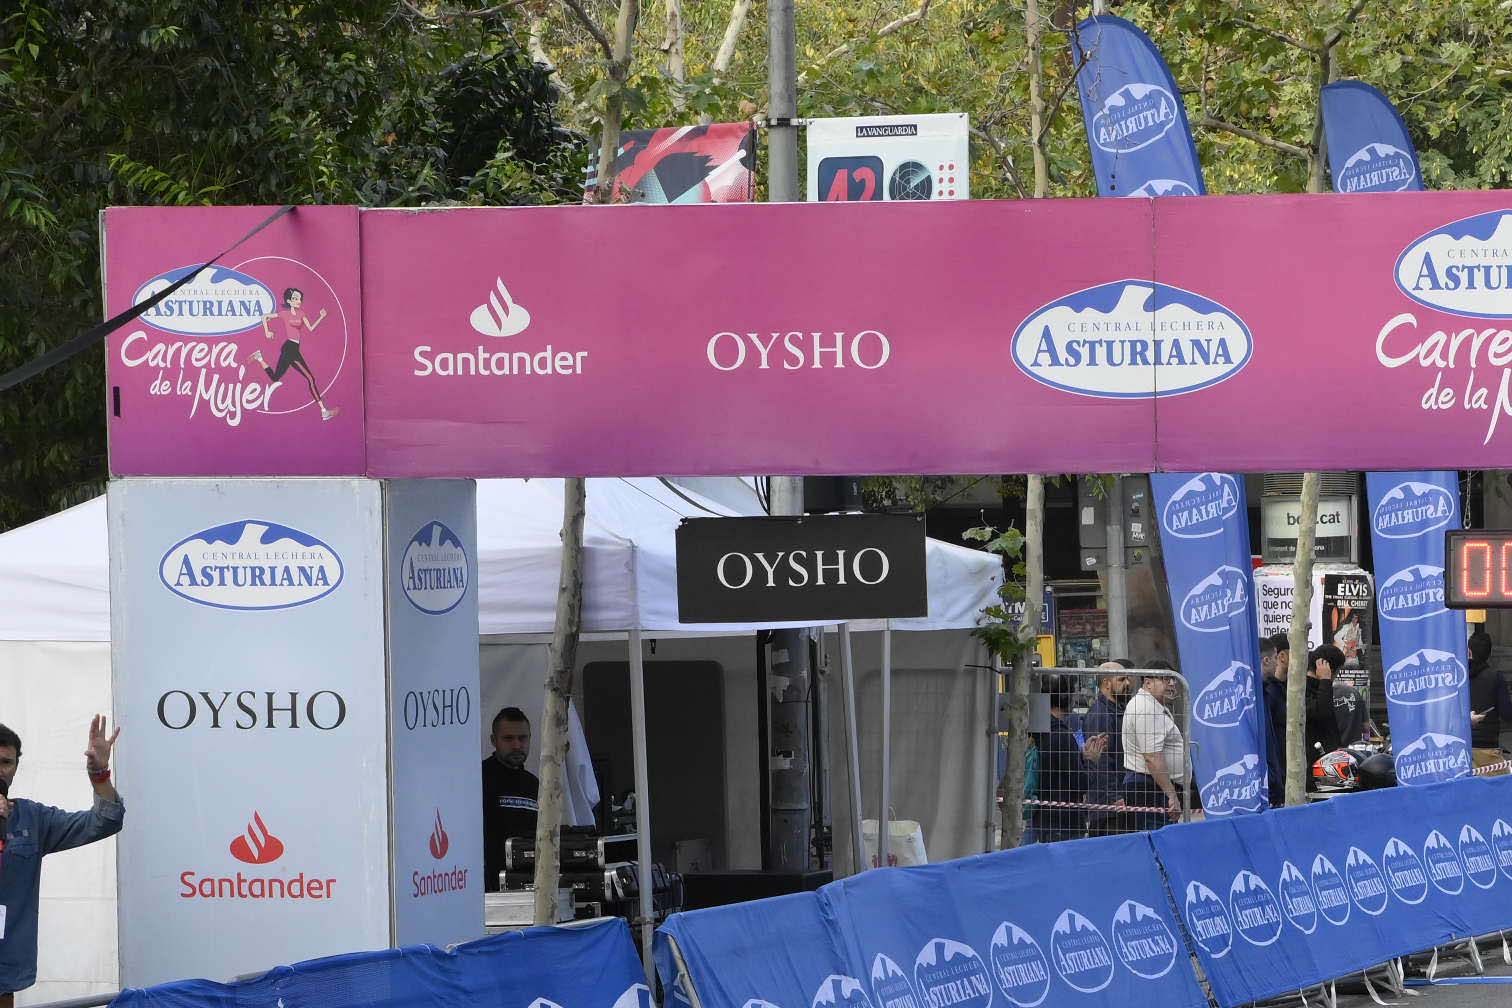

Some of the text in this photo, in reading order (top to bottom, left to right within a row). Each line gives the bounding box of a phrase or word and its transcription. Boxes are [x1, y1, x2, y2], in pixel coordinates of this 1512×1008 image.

[857, 125, 916, 136] LA VANGUARDIA
[172, 288, 209, 296] ENTRAL
[1067, 320, 1226, 332] CENTRAL LECHERA
[120, 330, 238, 368] Carrera
[413, 345, 588, 377] Santander
[706, 330, 891, 371] OYSHO
[1030, 324, 1234, 367] ASTURIANA
[149, 364, 283, 427] de la Mujer
[1421, 371, 1456, 411] de
[1463, 369, 1488, 411] la
[174, 553, 330, 587] ASTURIANA
[202, 551, 324, 560] CENTRAL LECHERA
[716, 547, 890, 589] OYSHO
[406, 555, 465, 592] ASTURIANA
[1337, 583, 1368, 596] ELVIS
[157, 690, 346, 731] OYSHO
[403, 686, 471, 731] OYSHO
[180, 871, 337, 899] Santander
[412, 864, 468, 899] Santander
[1056, 943, 1111, 975] ASTURIANA
